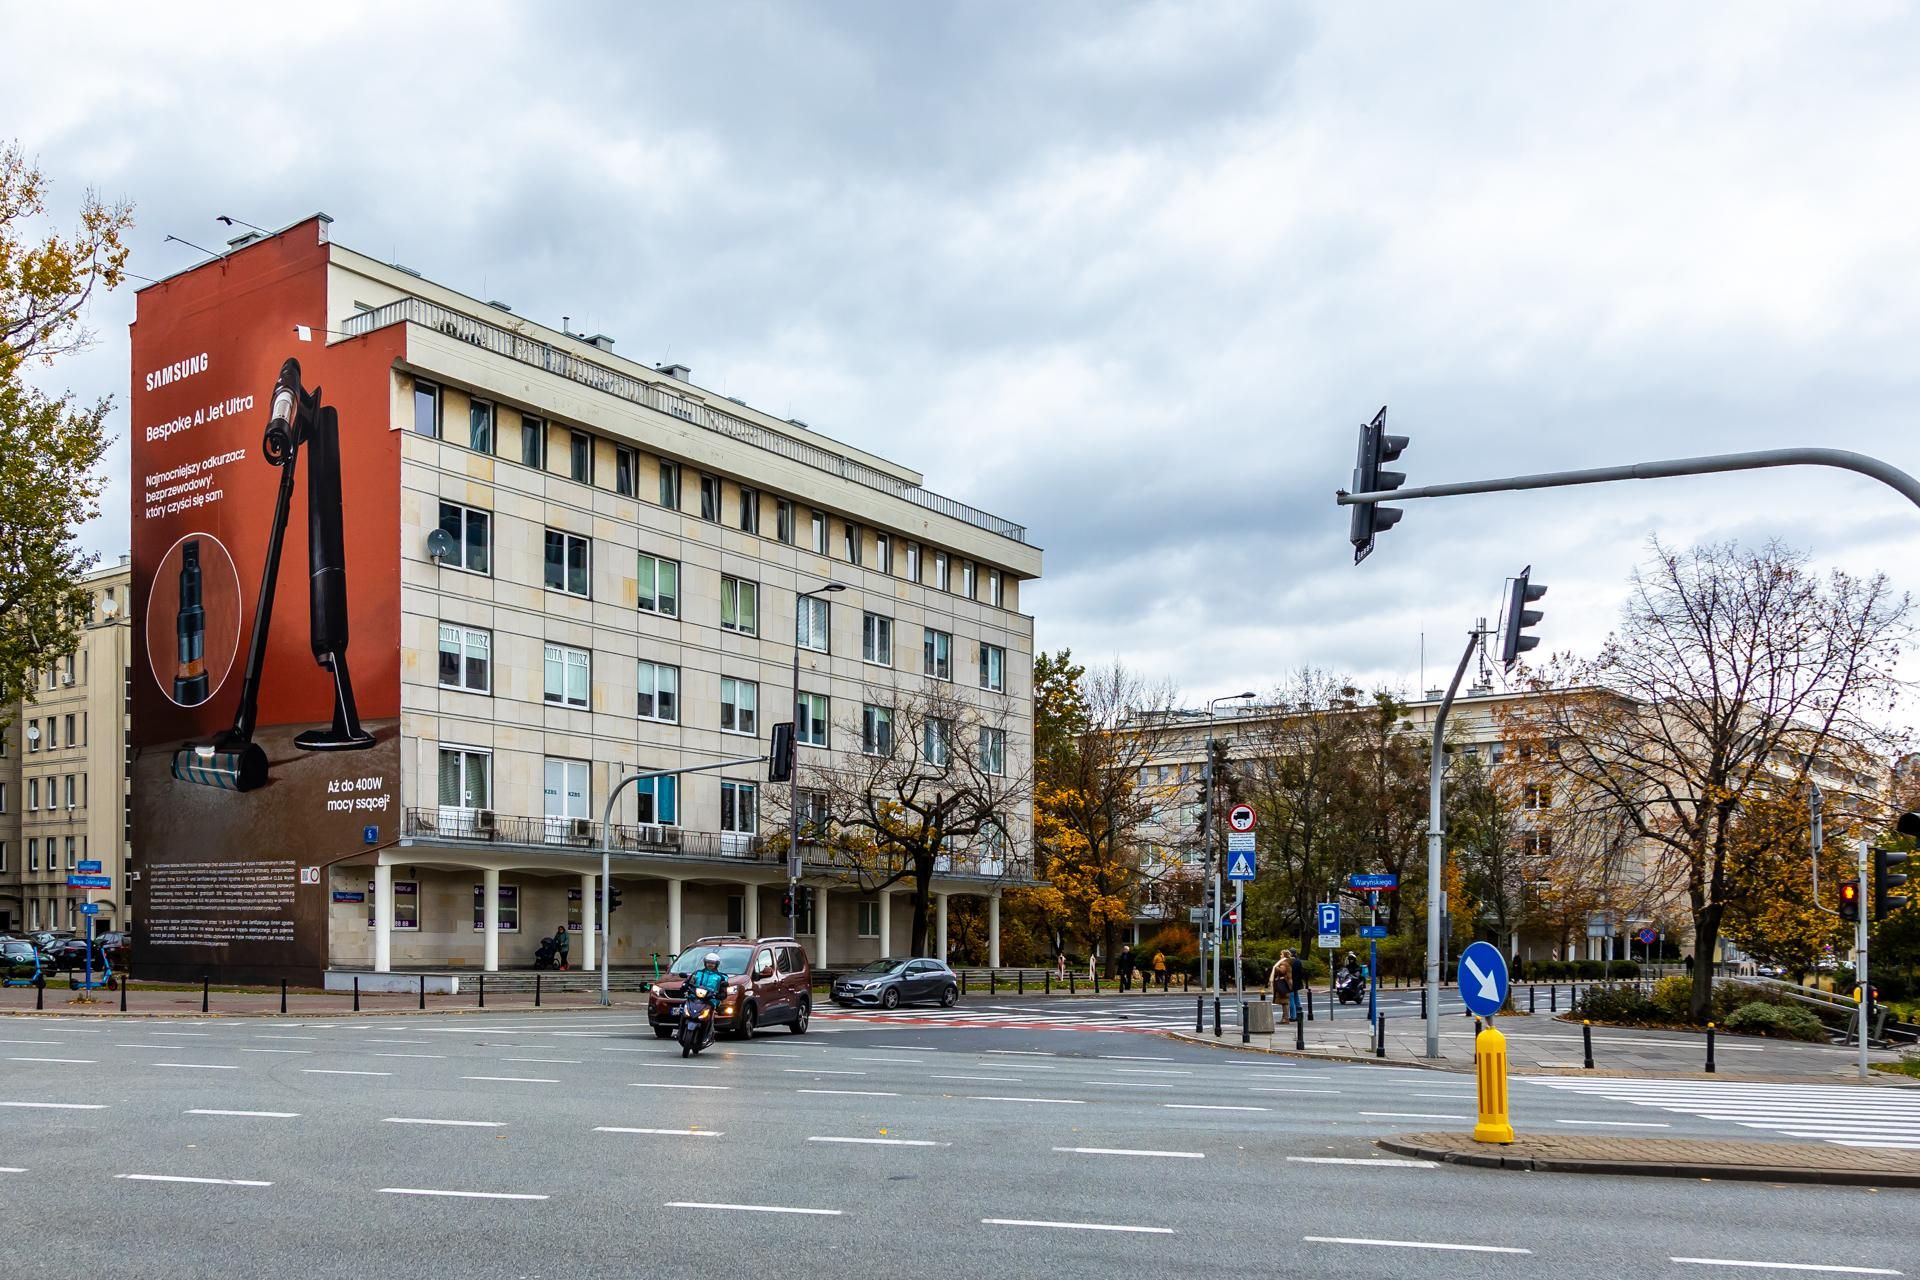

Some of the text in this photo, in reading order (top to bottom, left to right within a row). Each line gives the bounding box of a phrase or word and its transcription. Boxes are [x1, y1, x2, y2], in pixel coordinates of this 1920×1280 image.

[146, 352, 208, 391] SAMSUNG
[146, 395, 254, 441] Bespoke AI Jet Ultra
[146, 449, 246, 488] Najmocniejszy odkurzacz
[146, 489, 223, 519] który czyści się sam
[328, 776, 383, 793] Aż do 400W
[327, 799, 354, 813] mocy
[1354, 879, 1392, 888] Waryńskiego
[1323, 910, 1336, 929] P
